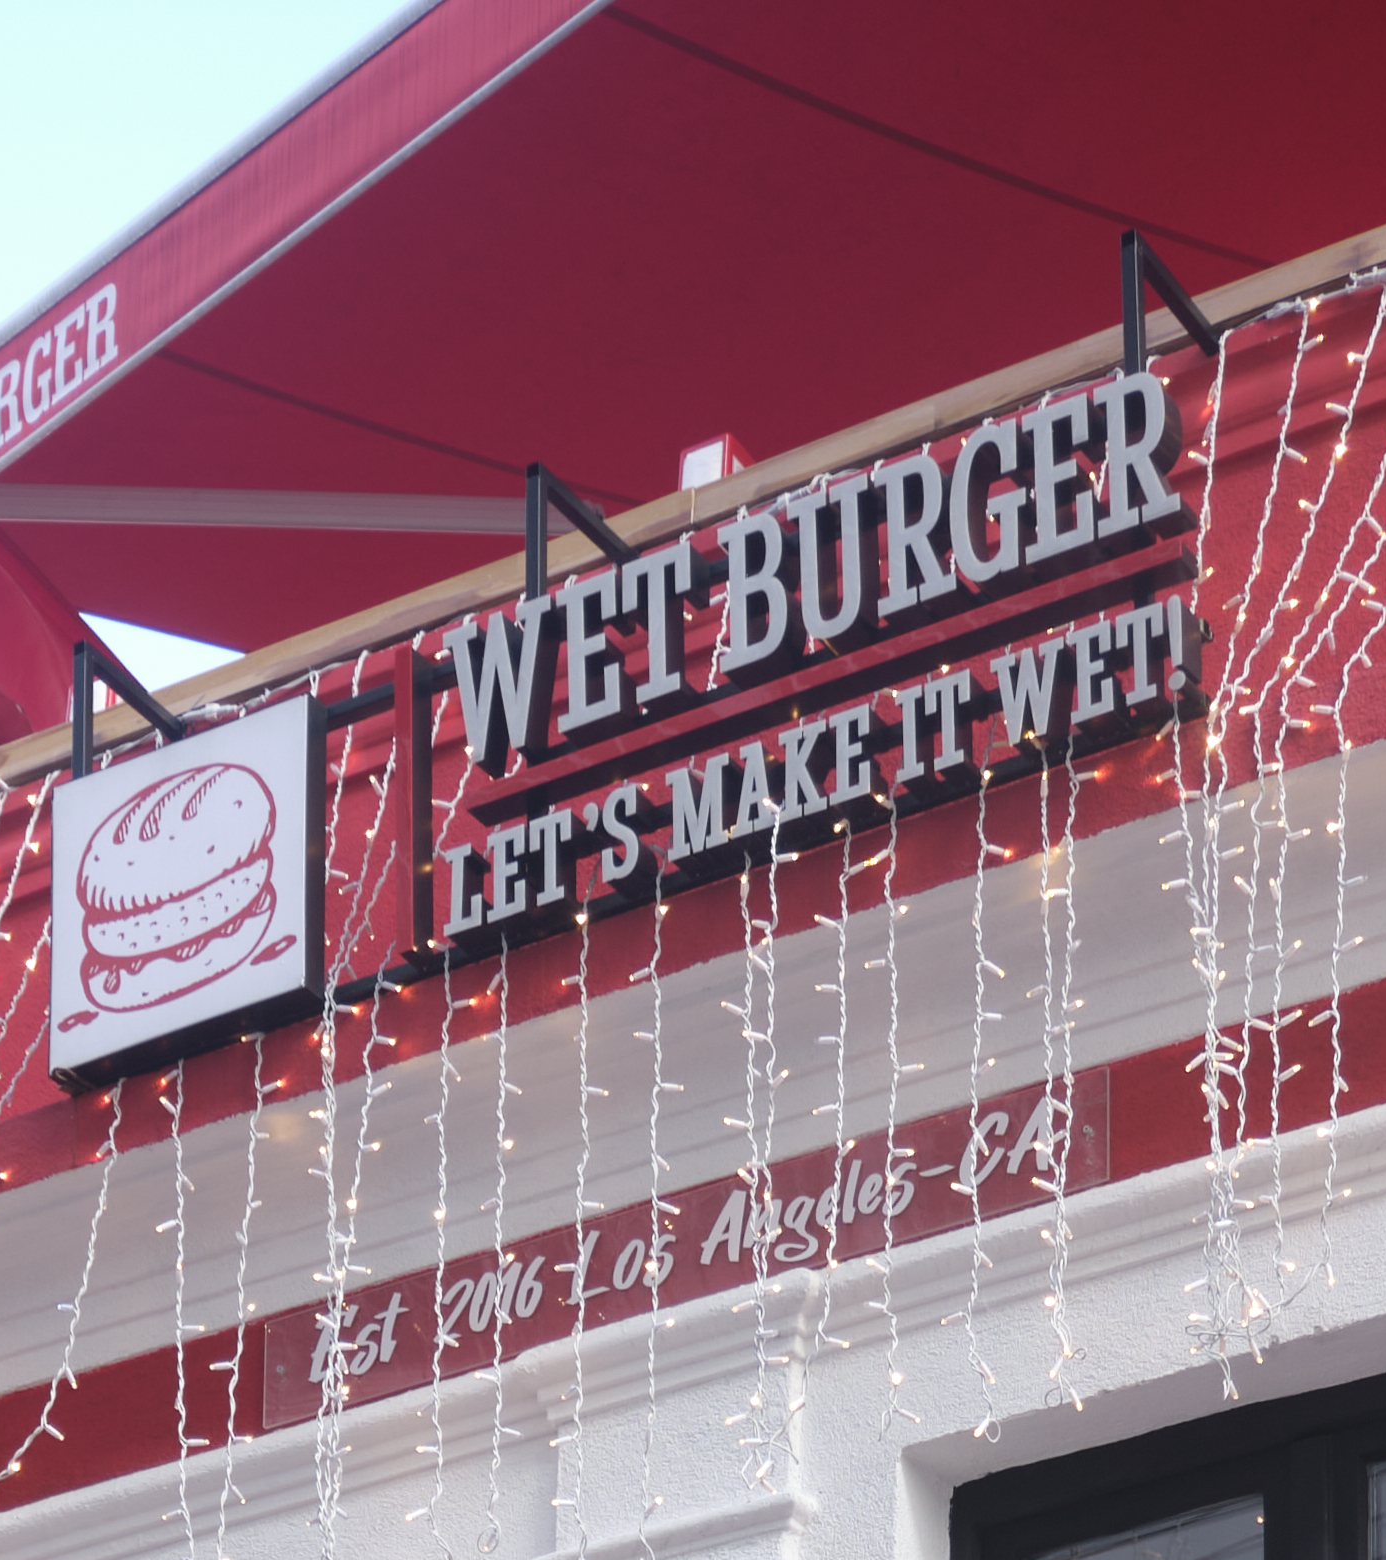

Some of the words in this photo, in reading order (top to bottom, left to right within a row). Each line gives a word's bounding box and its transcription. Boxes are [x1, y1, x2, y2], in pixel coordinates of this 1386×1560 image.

[443, 538, 691, 767] WET
[718, 372, 1181, 674] BURGER
[444, 782, 638, 937] LET'S
[668, 704, 872, 862] MAKE
[896, 669, 971, 782] IT
[991, 595, 1188, 747] WET!
[308, 1290, 410, 1383] Est
[440, 1256, 543, 1333] 2016
[562, 1230, 675, 1304] Los
